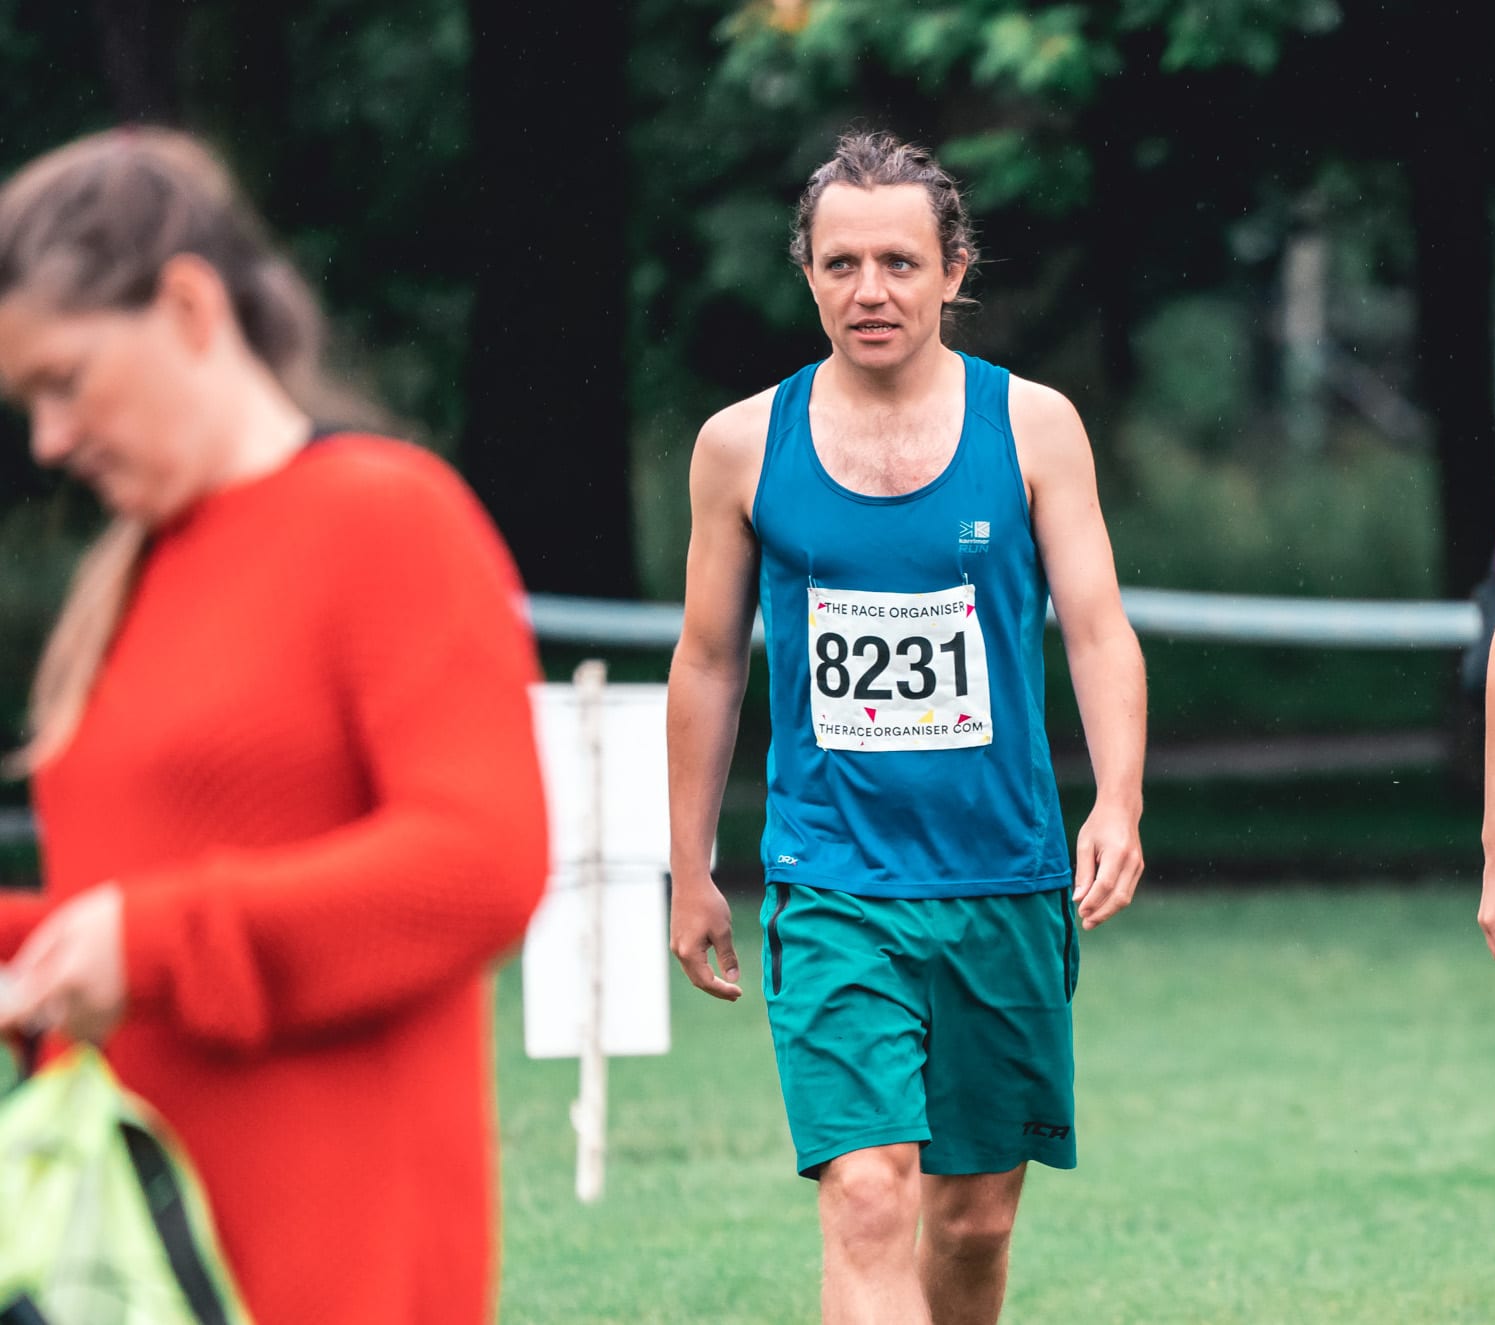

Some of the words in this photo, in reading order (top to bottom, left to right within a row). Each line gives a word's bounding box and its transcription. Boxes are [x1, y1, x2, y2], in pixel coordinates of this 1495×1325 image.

[825, 602, 848, 615] THE
[851, 604, 885, 618] RACE
[889, 600, 965, 618] ORGANISER
[816, 631, 968, 700] 8231
